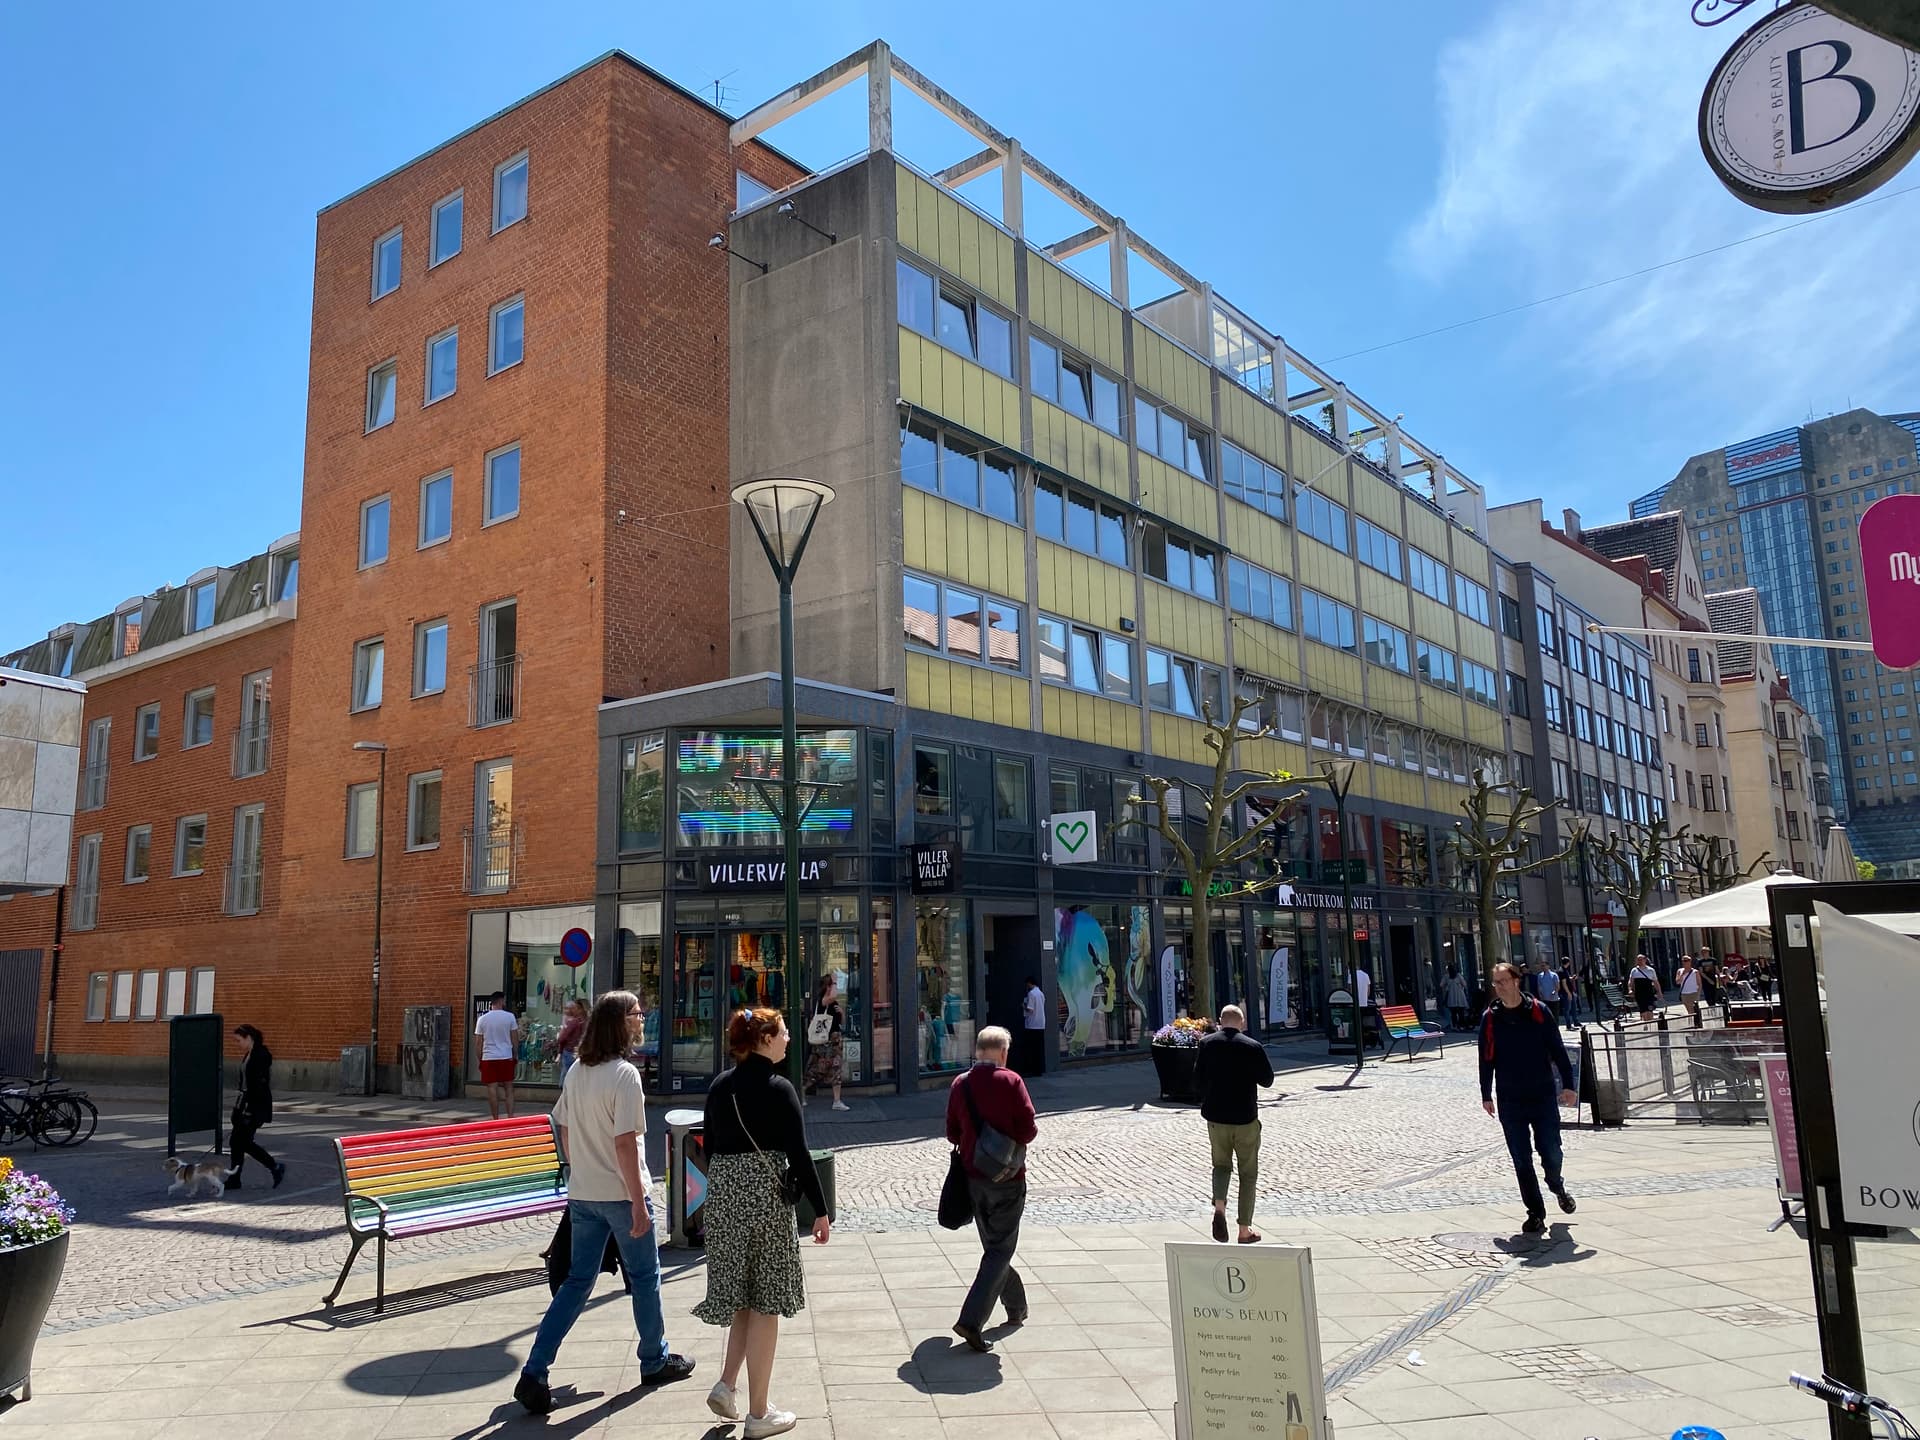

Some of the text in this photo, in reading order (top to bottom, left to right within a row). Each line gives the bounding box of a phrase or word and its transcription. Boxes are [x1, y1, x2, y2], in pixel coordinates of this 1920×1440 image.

[1787, 40, 1876, 155] B
[1769, 54, 1786, 160] BOW'S BEAUTY
[1729, 443, 1799, 471] Scandic
[917, 850, 949, 865] VILLER
[1295, 892, 1373, 910] NATURKOMANIET
[1226, 1266, 1246, 1294] B
[1193, 1306, 1289, 1323] BOW'S BEAUTY
[1199, 1349, 1215, 1359] Nytt
[1216, 1351, 1227, 1359] set
[1228, 1351, 1241, 1361] färg
[1201, 1366, 1225, 1377] Pedikyr
[1226, 1368, 1240, 1377] från
